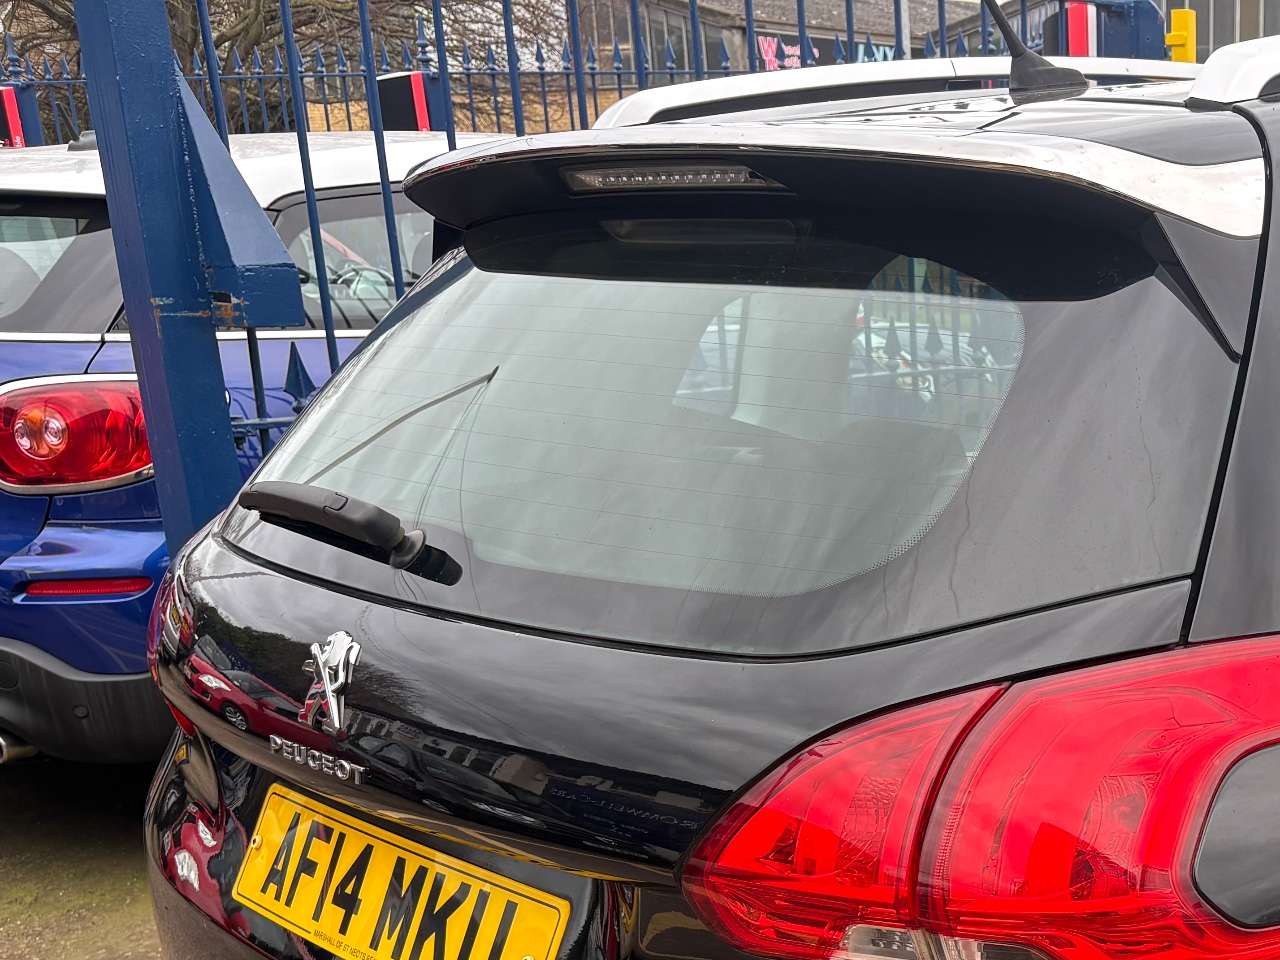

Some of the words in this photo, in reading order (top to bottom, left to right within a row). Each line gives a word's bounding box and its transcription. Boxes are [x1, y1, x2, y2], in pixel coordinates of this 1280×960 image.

[269, 734, 367, 785] PEUGEOT
[260, 812, 374, 936] AF14
[314, 929, 336, 947] MARSHALL
[350, 946, 367, 960] NEOTS
